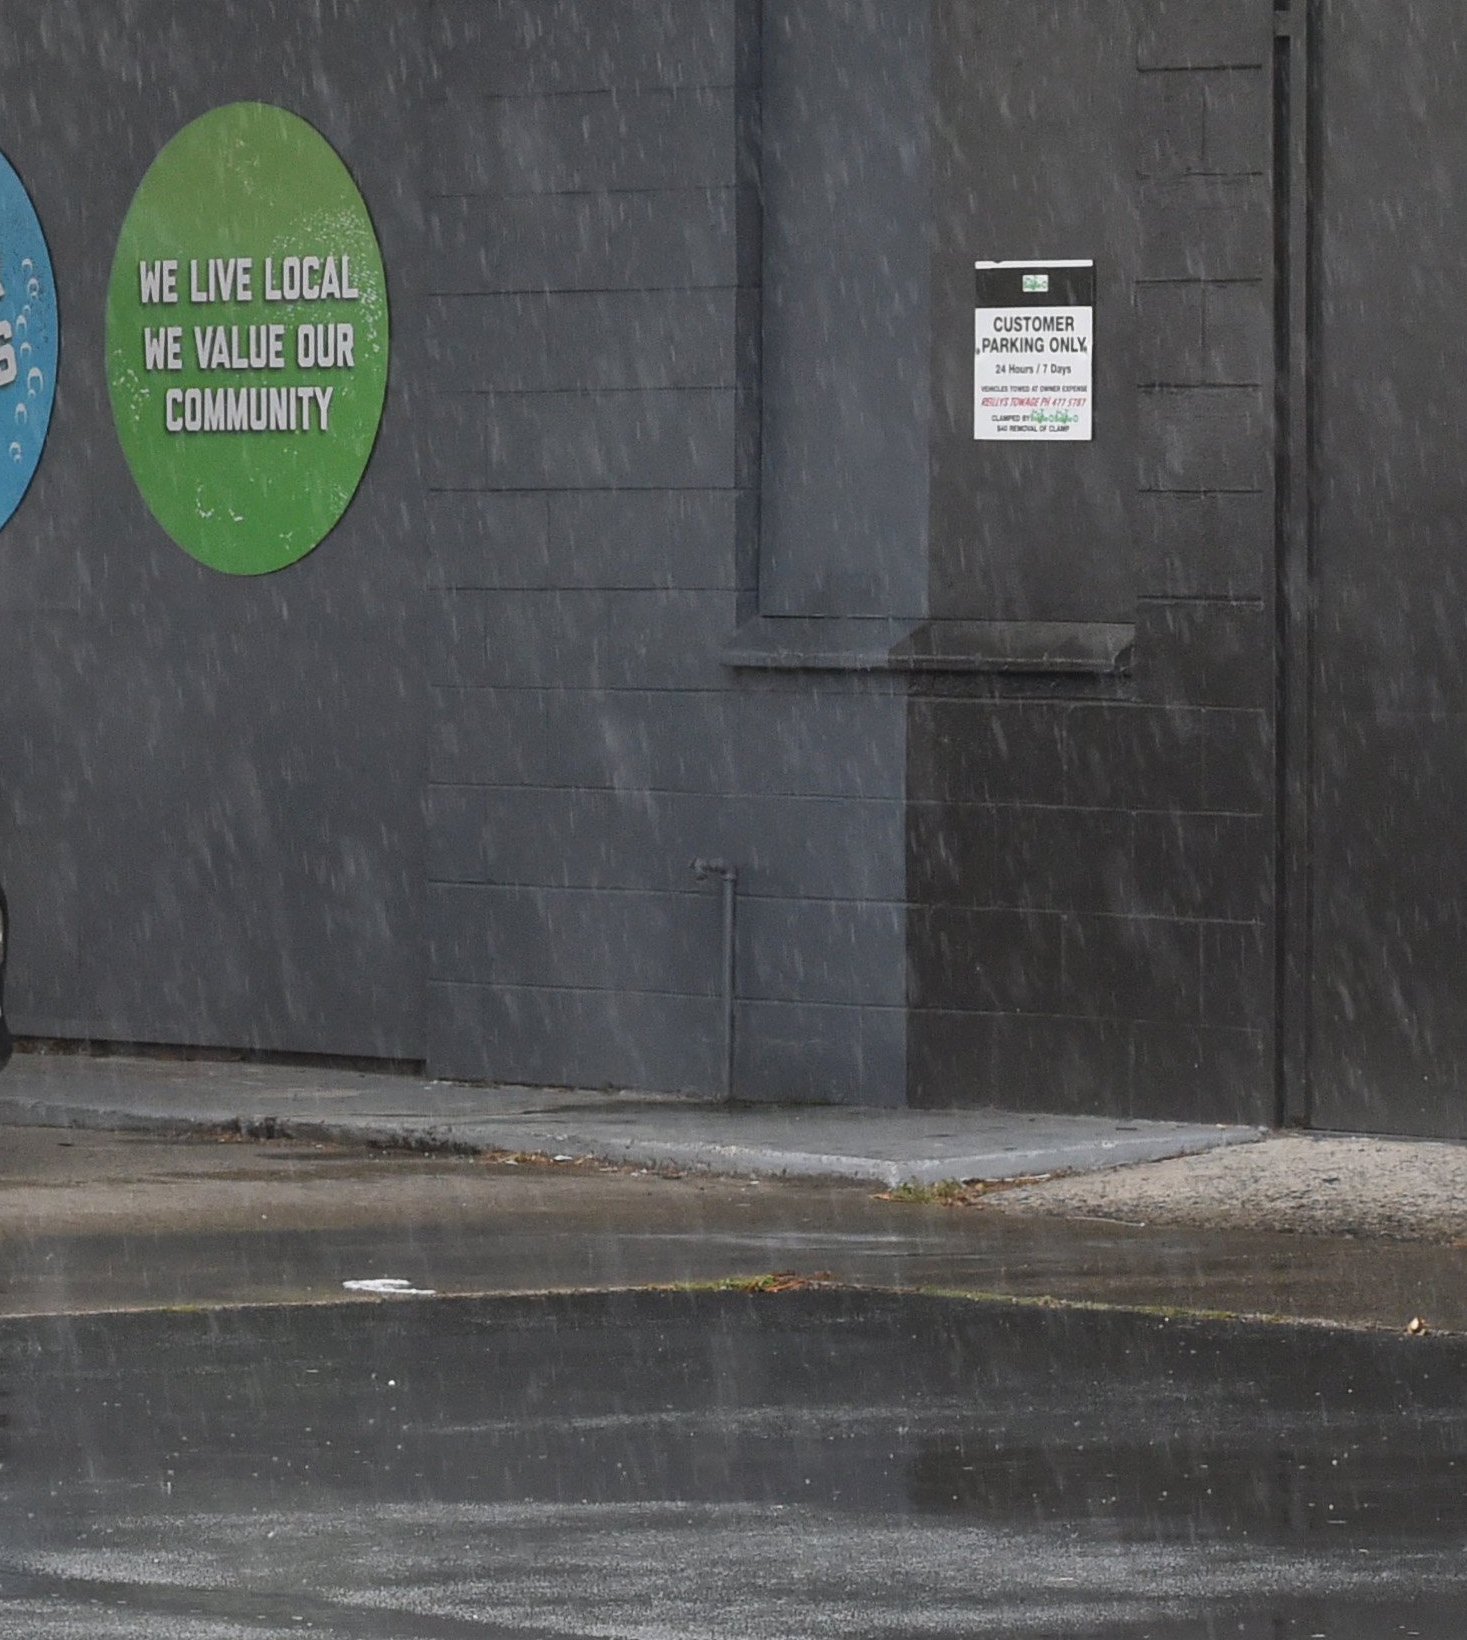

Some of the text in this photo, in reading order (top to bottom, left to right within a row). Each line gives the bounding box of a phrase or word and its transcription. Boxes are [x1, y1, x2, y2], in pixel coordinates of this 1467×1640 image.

[139, 255, 360, 304] WE LIVE LOCAL
[993, 316, 1075, 332] CUSTOMER
[143, 323, 355, 371] WE VALUE OUR
[982, 336, 1087, 353] PARKING ONLY
[995, 364, 1006, 374] 24
[1009, 364, 1034, 374] Hours
[1043, 364, 1048, 373] 7
[1050, 363, 1072, 375] Days
[165, 387, 334, 433] COMMUNITY
[1010, 397, 1039, 407] TOWAGE
[1052, 398, 1067, 406] 477
